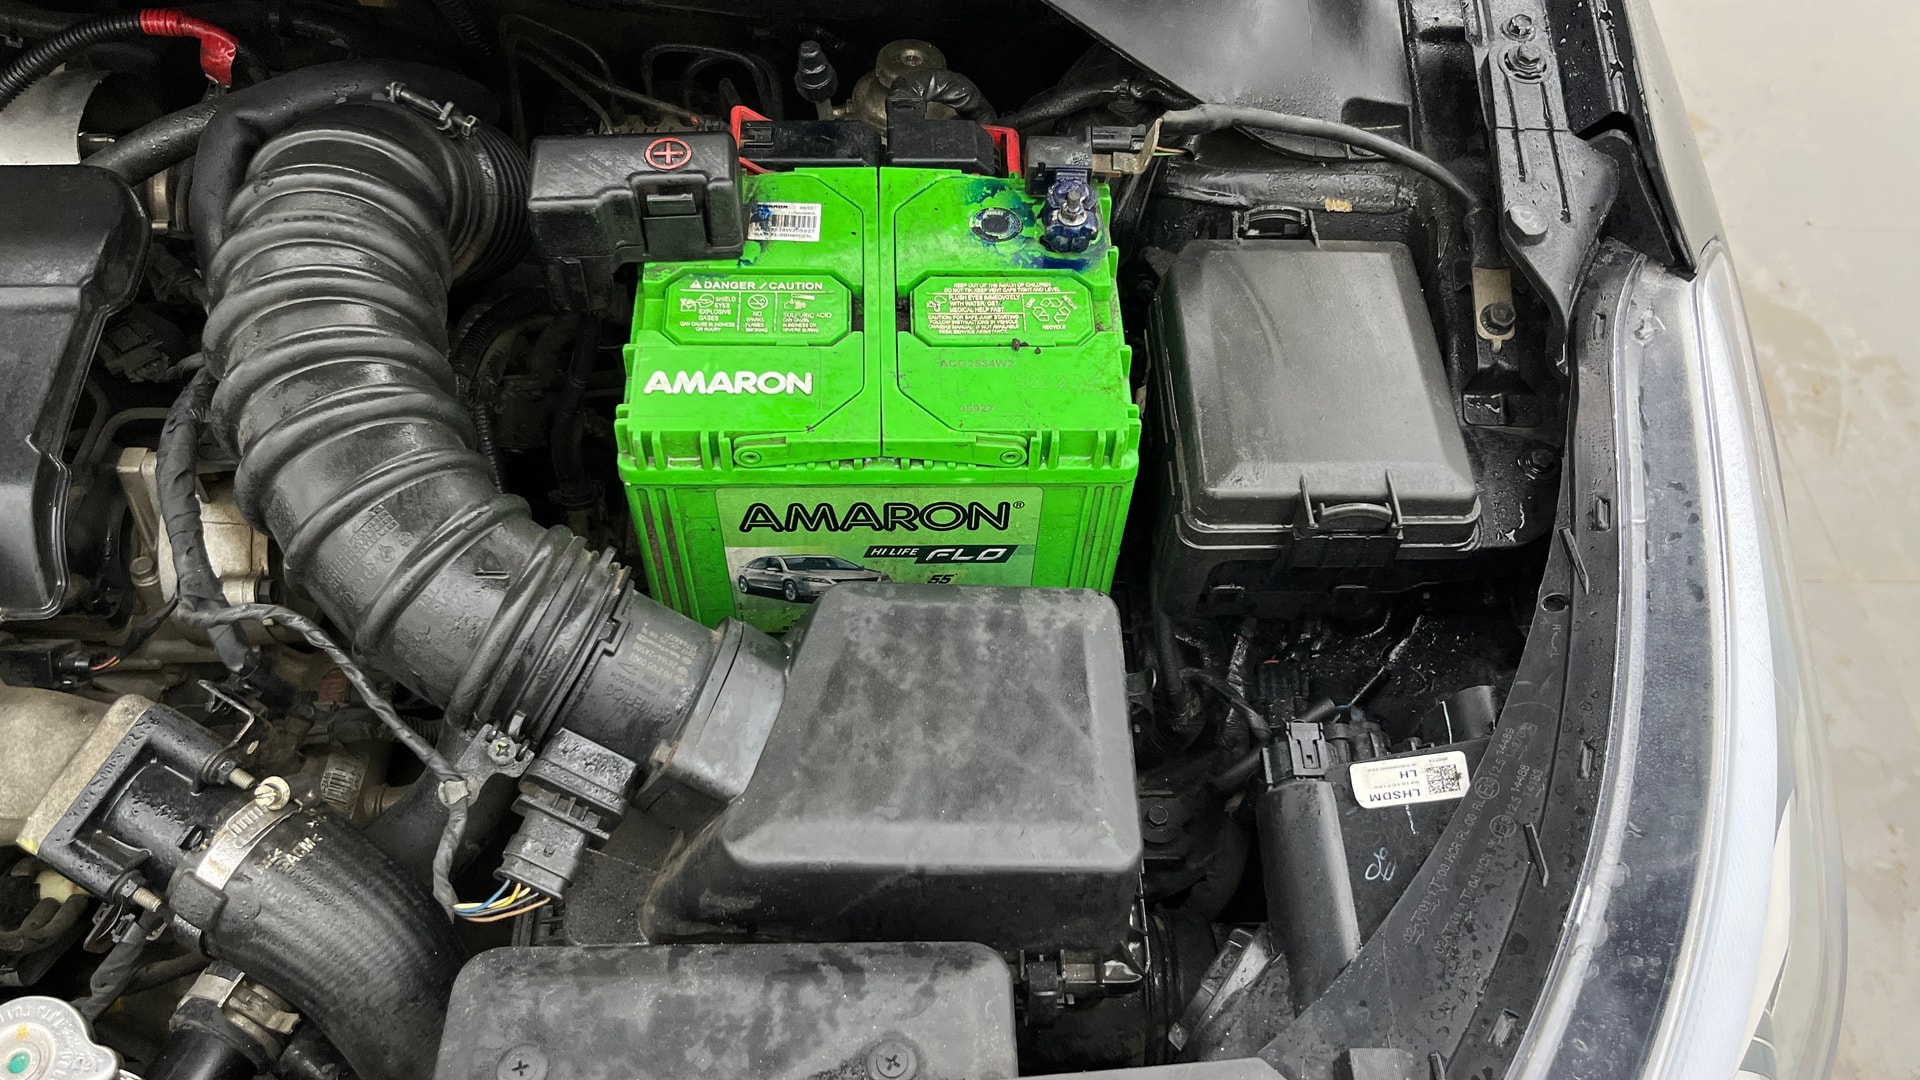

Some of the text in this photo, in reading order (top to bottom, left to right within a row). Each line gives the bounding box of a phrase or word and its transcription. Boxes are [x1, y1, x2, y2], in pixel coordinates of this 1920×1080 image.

[703, 281, 756, 290] DANGER
[769, 282, 823, 290] CAUTION
[643, 370, 814, 395] AMARON
[870, 547, 1008, 561] HI LIFE FLO
[1399, 769, 1418, 779] LH
[1369, 788, 1421, 802] LHSDM
